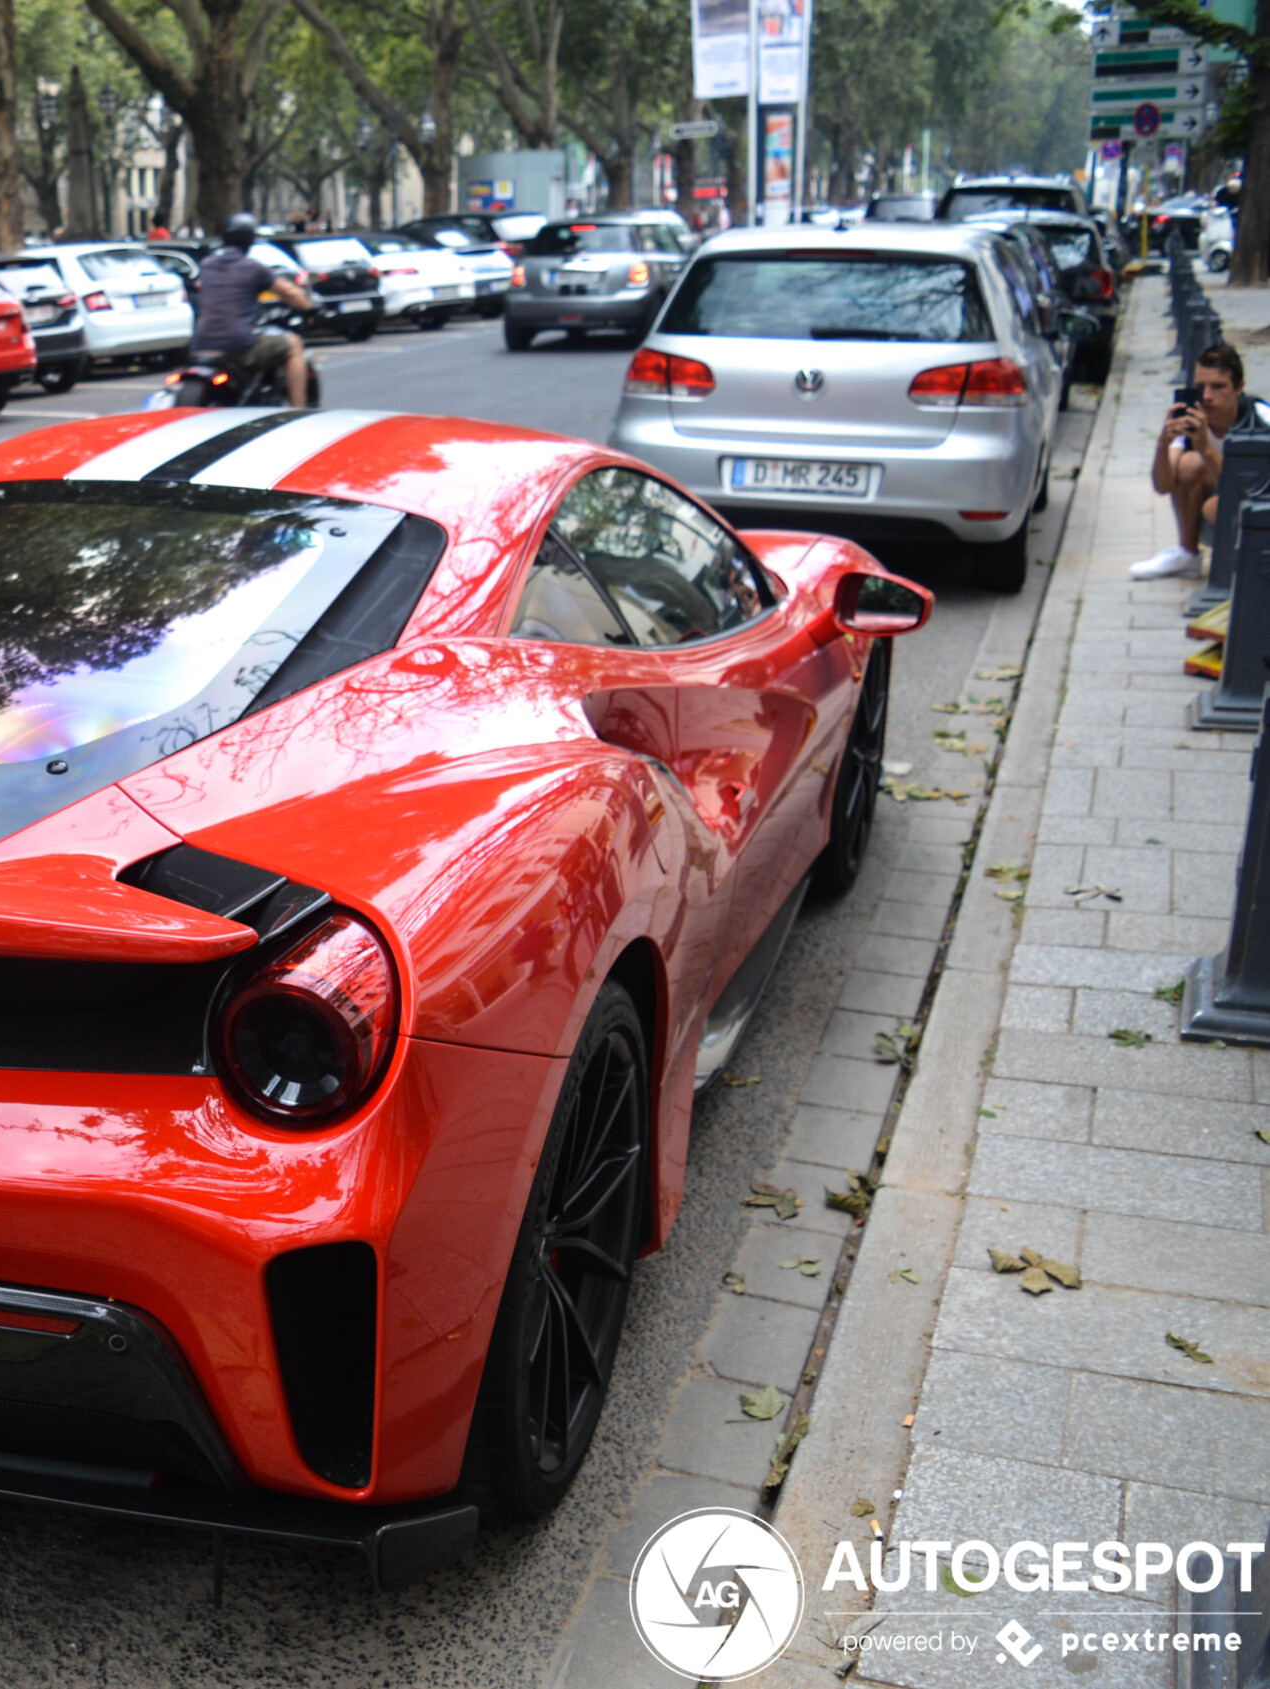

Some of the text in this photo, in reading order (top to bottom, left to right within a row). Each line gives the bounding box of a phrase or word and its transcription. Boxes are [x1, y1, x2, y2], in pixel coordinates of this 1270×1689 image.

[753, 462, 861, 488] D MR 245
